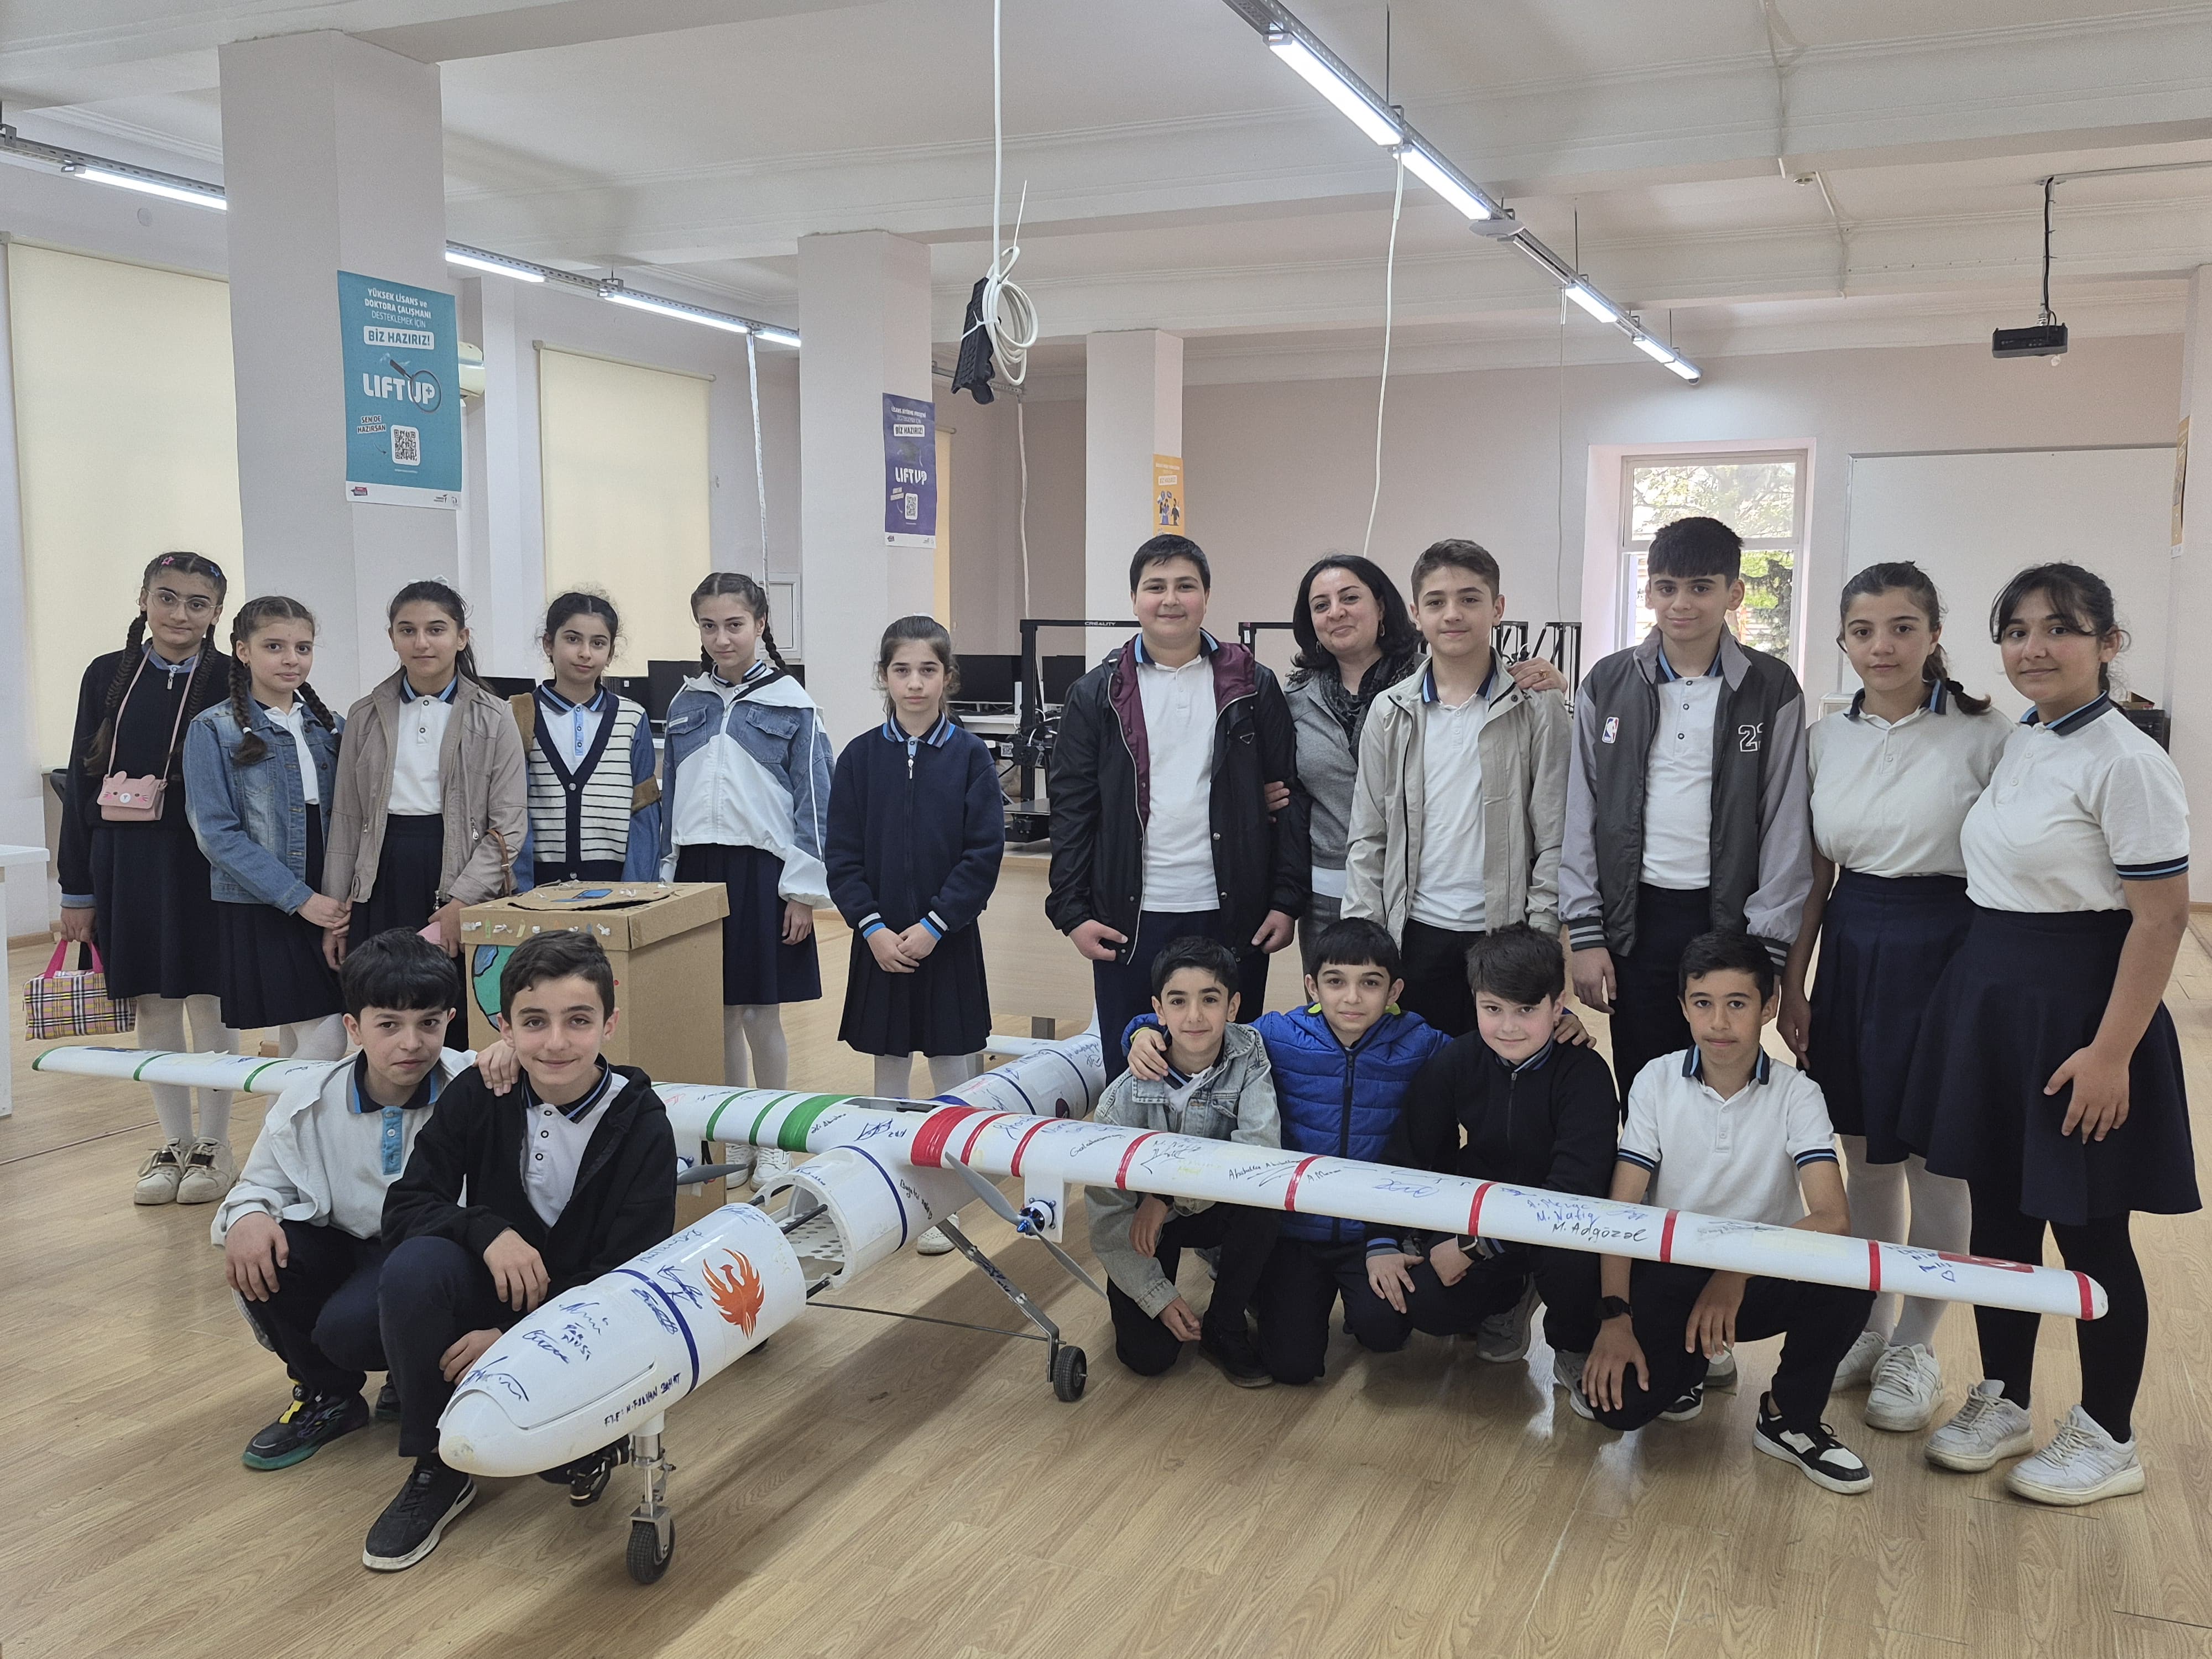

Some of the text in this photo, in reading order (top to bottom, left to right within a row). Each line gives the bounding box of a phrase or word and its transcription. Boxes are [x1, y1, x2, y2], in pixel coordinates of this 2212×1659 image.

[368, 288, 394, 301] YÜKSEK
[396, 293, 418, 305] LİSANS
[365, 299, 431, 319] DOKTORA ÇALIŞMANI
[372, 310, 426, 328] DESTEKLEMEK İÇİN
[368, 328, 430, 346] BİZ HAZIRIZ!
[357, 424, 386, 432] HAZIRSAN
